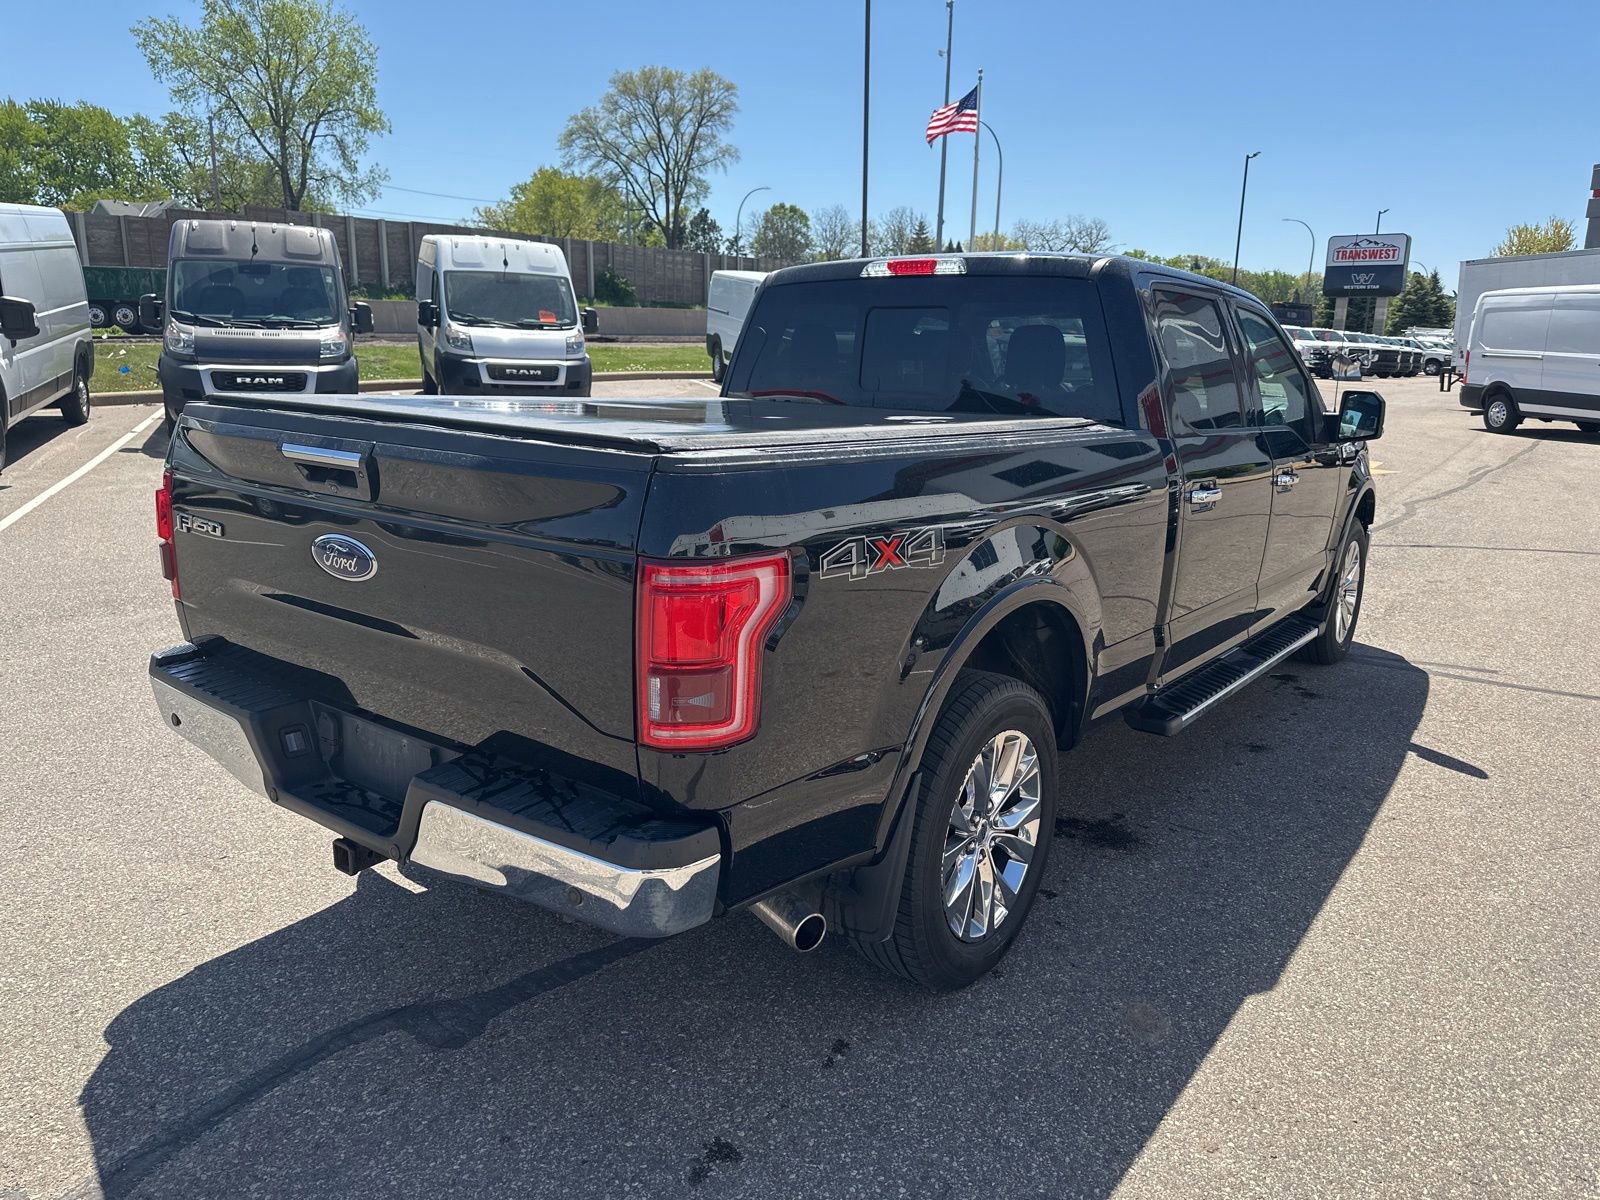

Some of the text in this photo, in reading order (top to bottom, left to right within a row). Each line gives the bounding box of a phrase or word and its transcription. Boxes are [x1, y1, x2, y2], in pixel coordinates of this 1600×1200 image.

[1335, 248, 1398, 260] TRANSWEST
[504, 368, 542, 376] RAM
[323, 543, 358, 572] Ford
